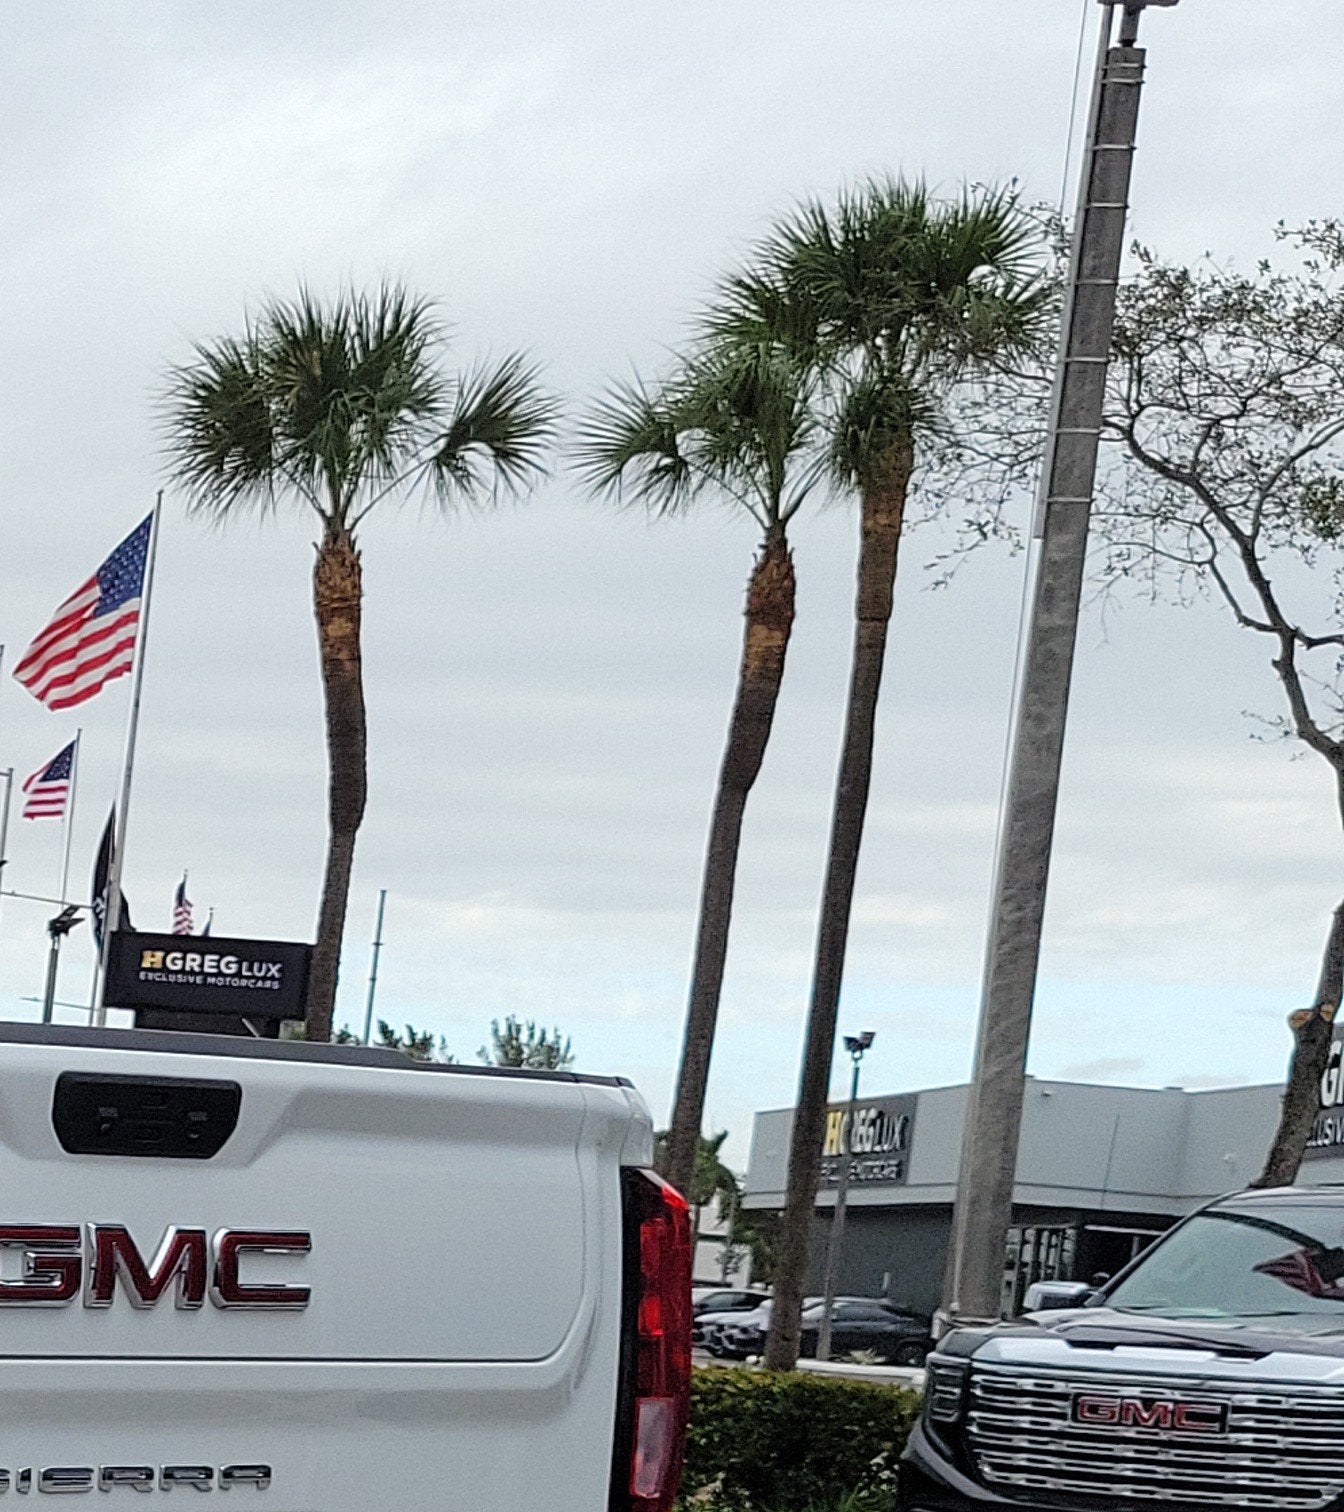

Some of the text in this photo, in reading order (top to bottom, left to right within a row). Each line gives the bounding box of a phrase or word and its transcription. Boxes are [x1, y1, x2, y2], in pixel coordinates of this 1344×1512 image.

[138, 971, 281, 990] EXCLUSIVE MOTORCARS
[1077, 1395, 1222, 1433] GMC
